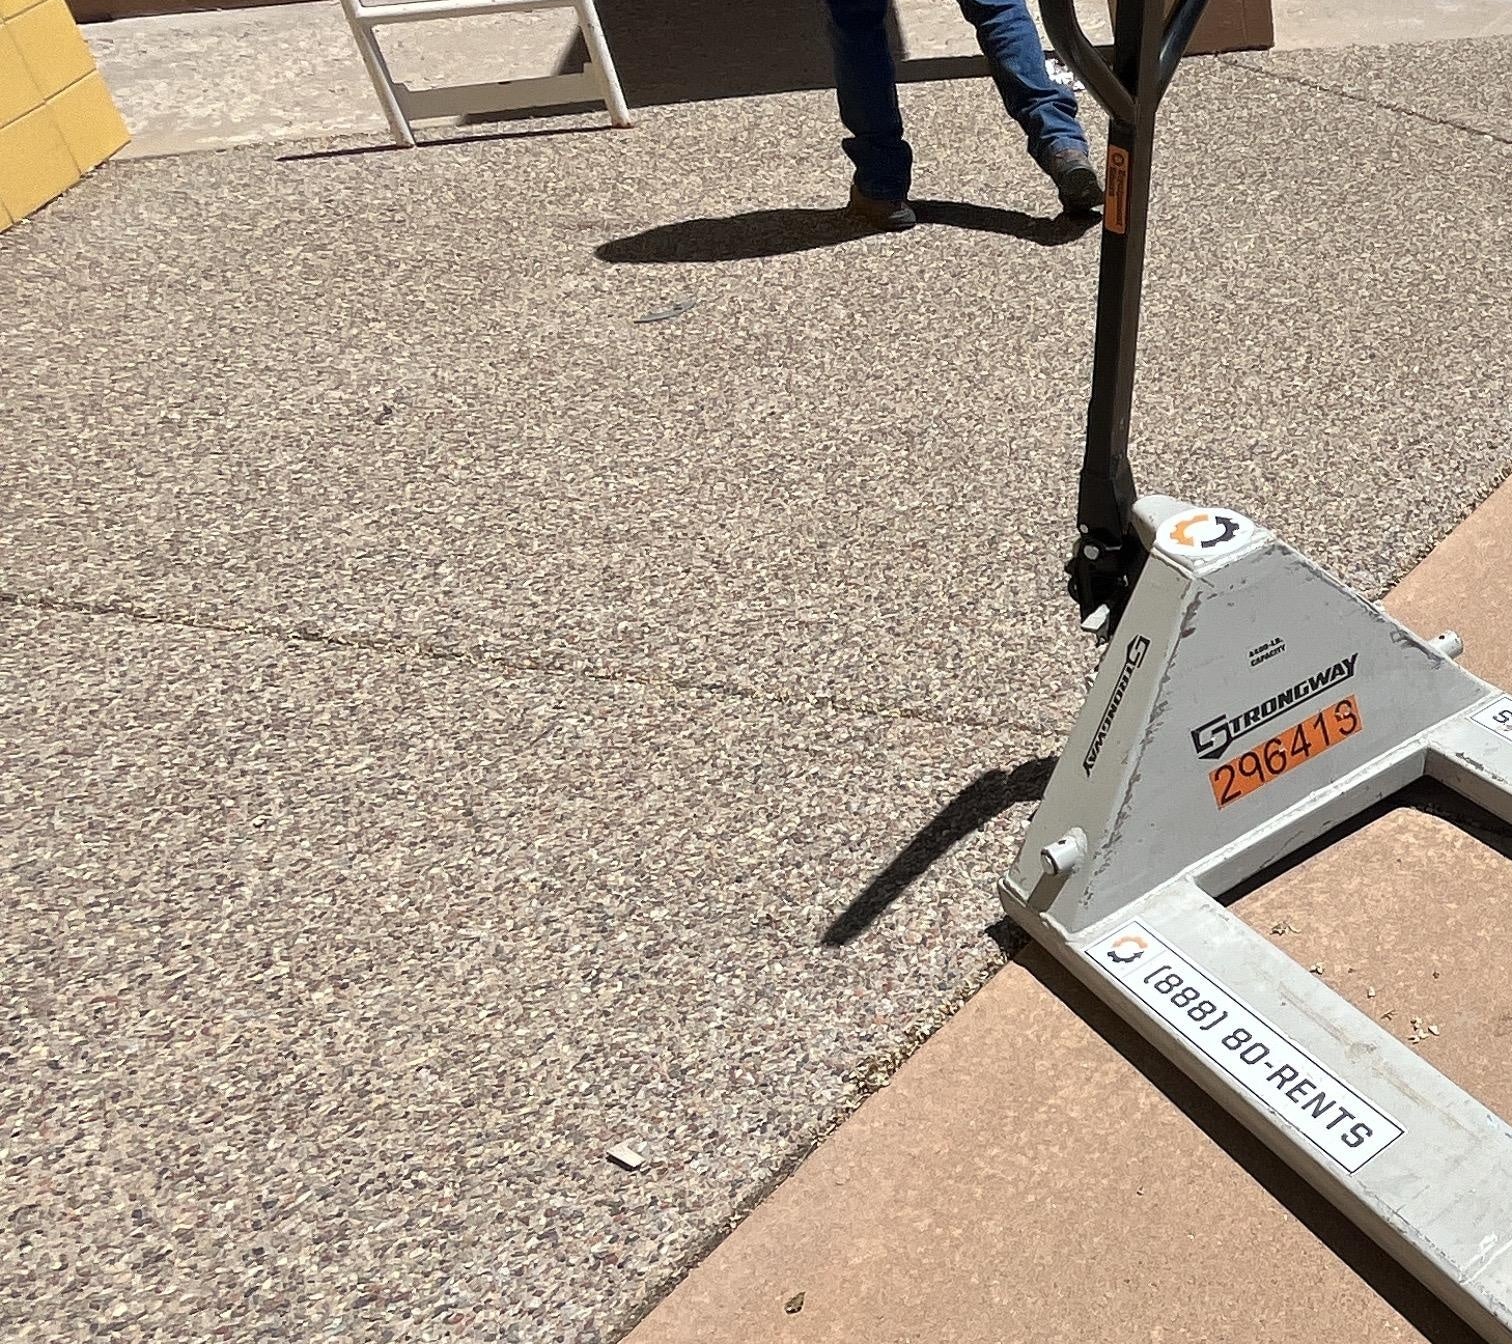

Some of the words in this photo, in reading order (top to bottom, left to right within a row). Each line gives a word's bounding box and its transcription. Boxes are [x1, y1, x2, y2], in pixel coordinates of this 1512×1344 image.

[1083, 634, 1151, 777] STRONGWAY
[1191, 653, 1359, 759] STRONGWAY
[1143, 964, 1228, 1031] (888)
[1221, 1027, 1374, 1149] 80-RENTS
